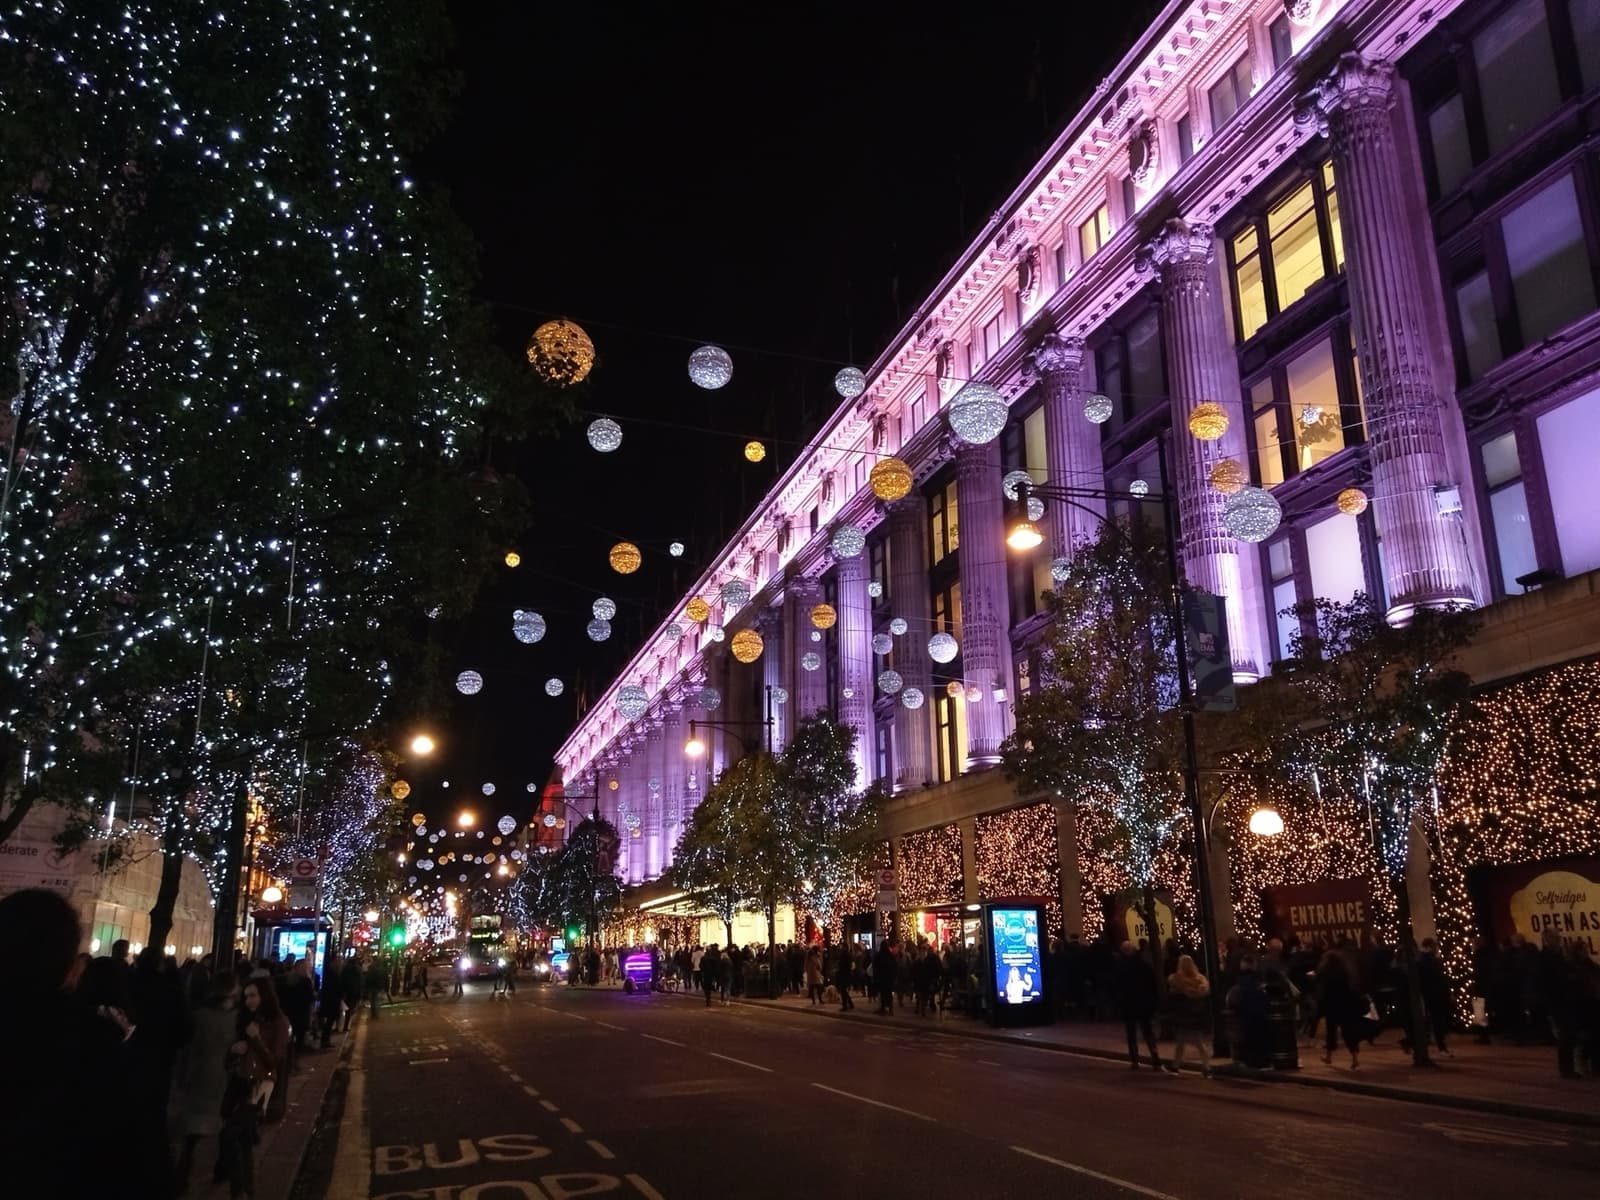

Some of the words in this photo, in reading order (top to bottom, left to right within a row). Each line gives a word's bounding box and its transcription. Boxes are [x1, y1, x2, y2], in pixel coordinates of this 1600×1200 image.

[1536, 890, 1587, 910] Selfridges
[1290, 901, 1365, 926] ENTRANCE
[1531, 912, 1575, 933] OPEN
[1580, 911, 1600, 931] AS
[1295, 930, 1328, 949] THIS
[373, 1134, 552, 1176] BUS
